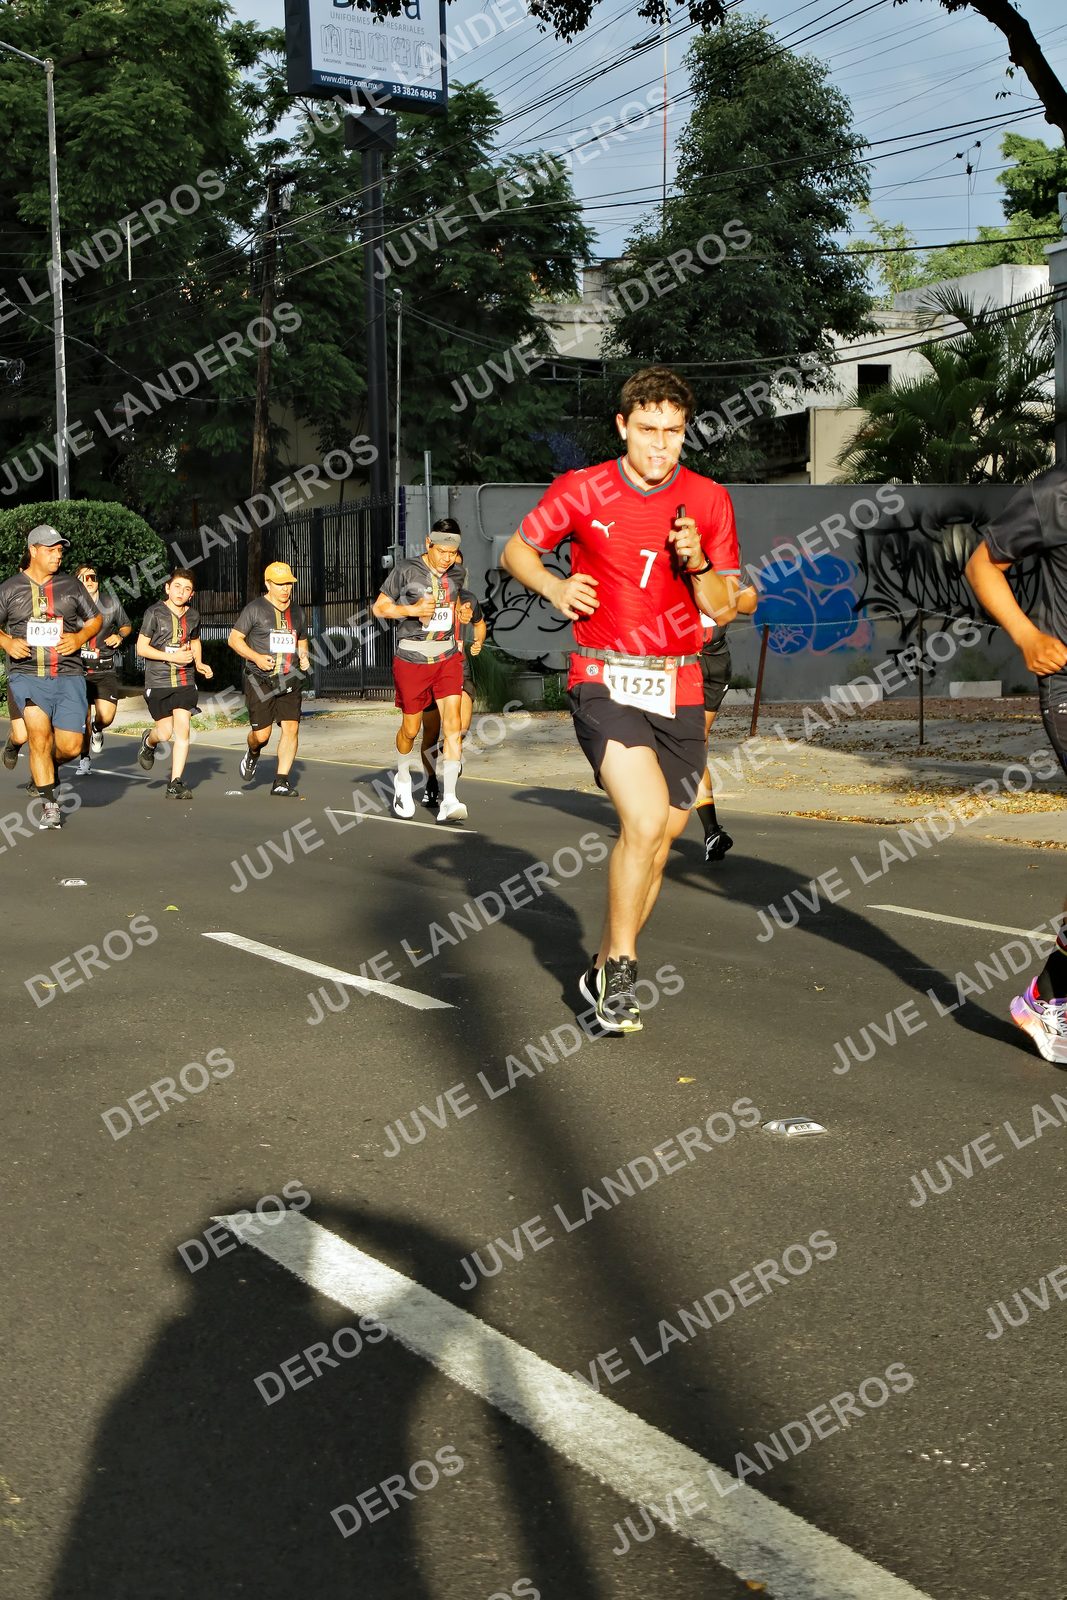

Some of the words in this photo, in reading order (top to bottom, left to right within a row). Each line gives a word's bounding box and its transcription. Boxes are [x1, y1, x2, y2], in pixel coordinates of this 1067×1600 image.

[330, 11, 370, 26] UNIFORMES
[320, 73, 378, 90] www.dibra.com.mx
[392, 85, 401, 94] 33
[402, 86, 419, 97] 3826
[420, 88, 437, 100] 4845
[639, 548, 659, 589] 7
[30, 626, 59, 636] 10349
[272, 636, 294, 645] 12253
[608, 675, 666, 697] 11525
